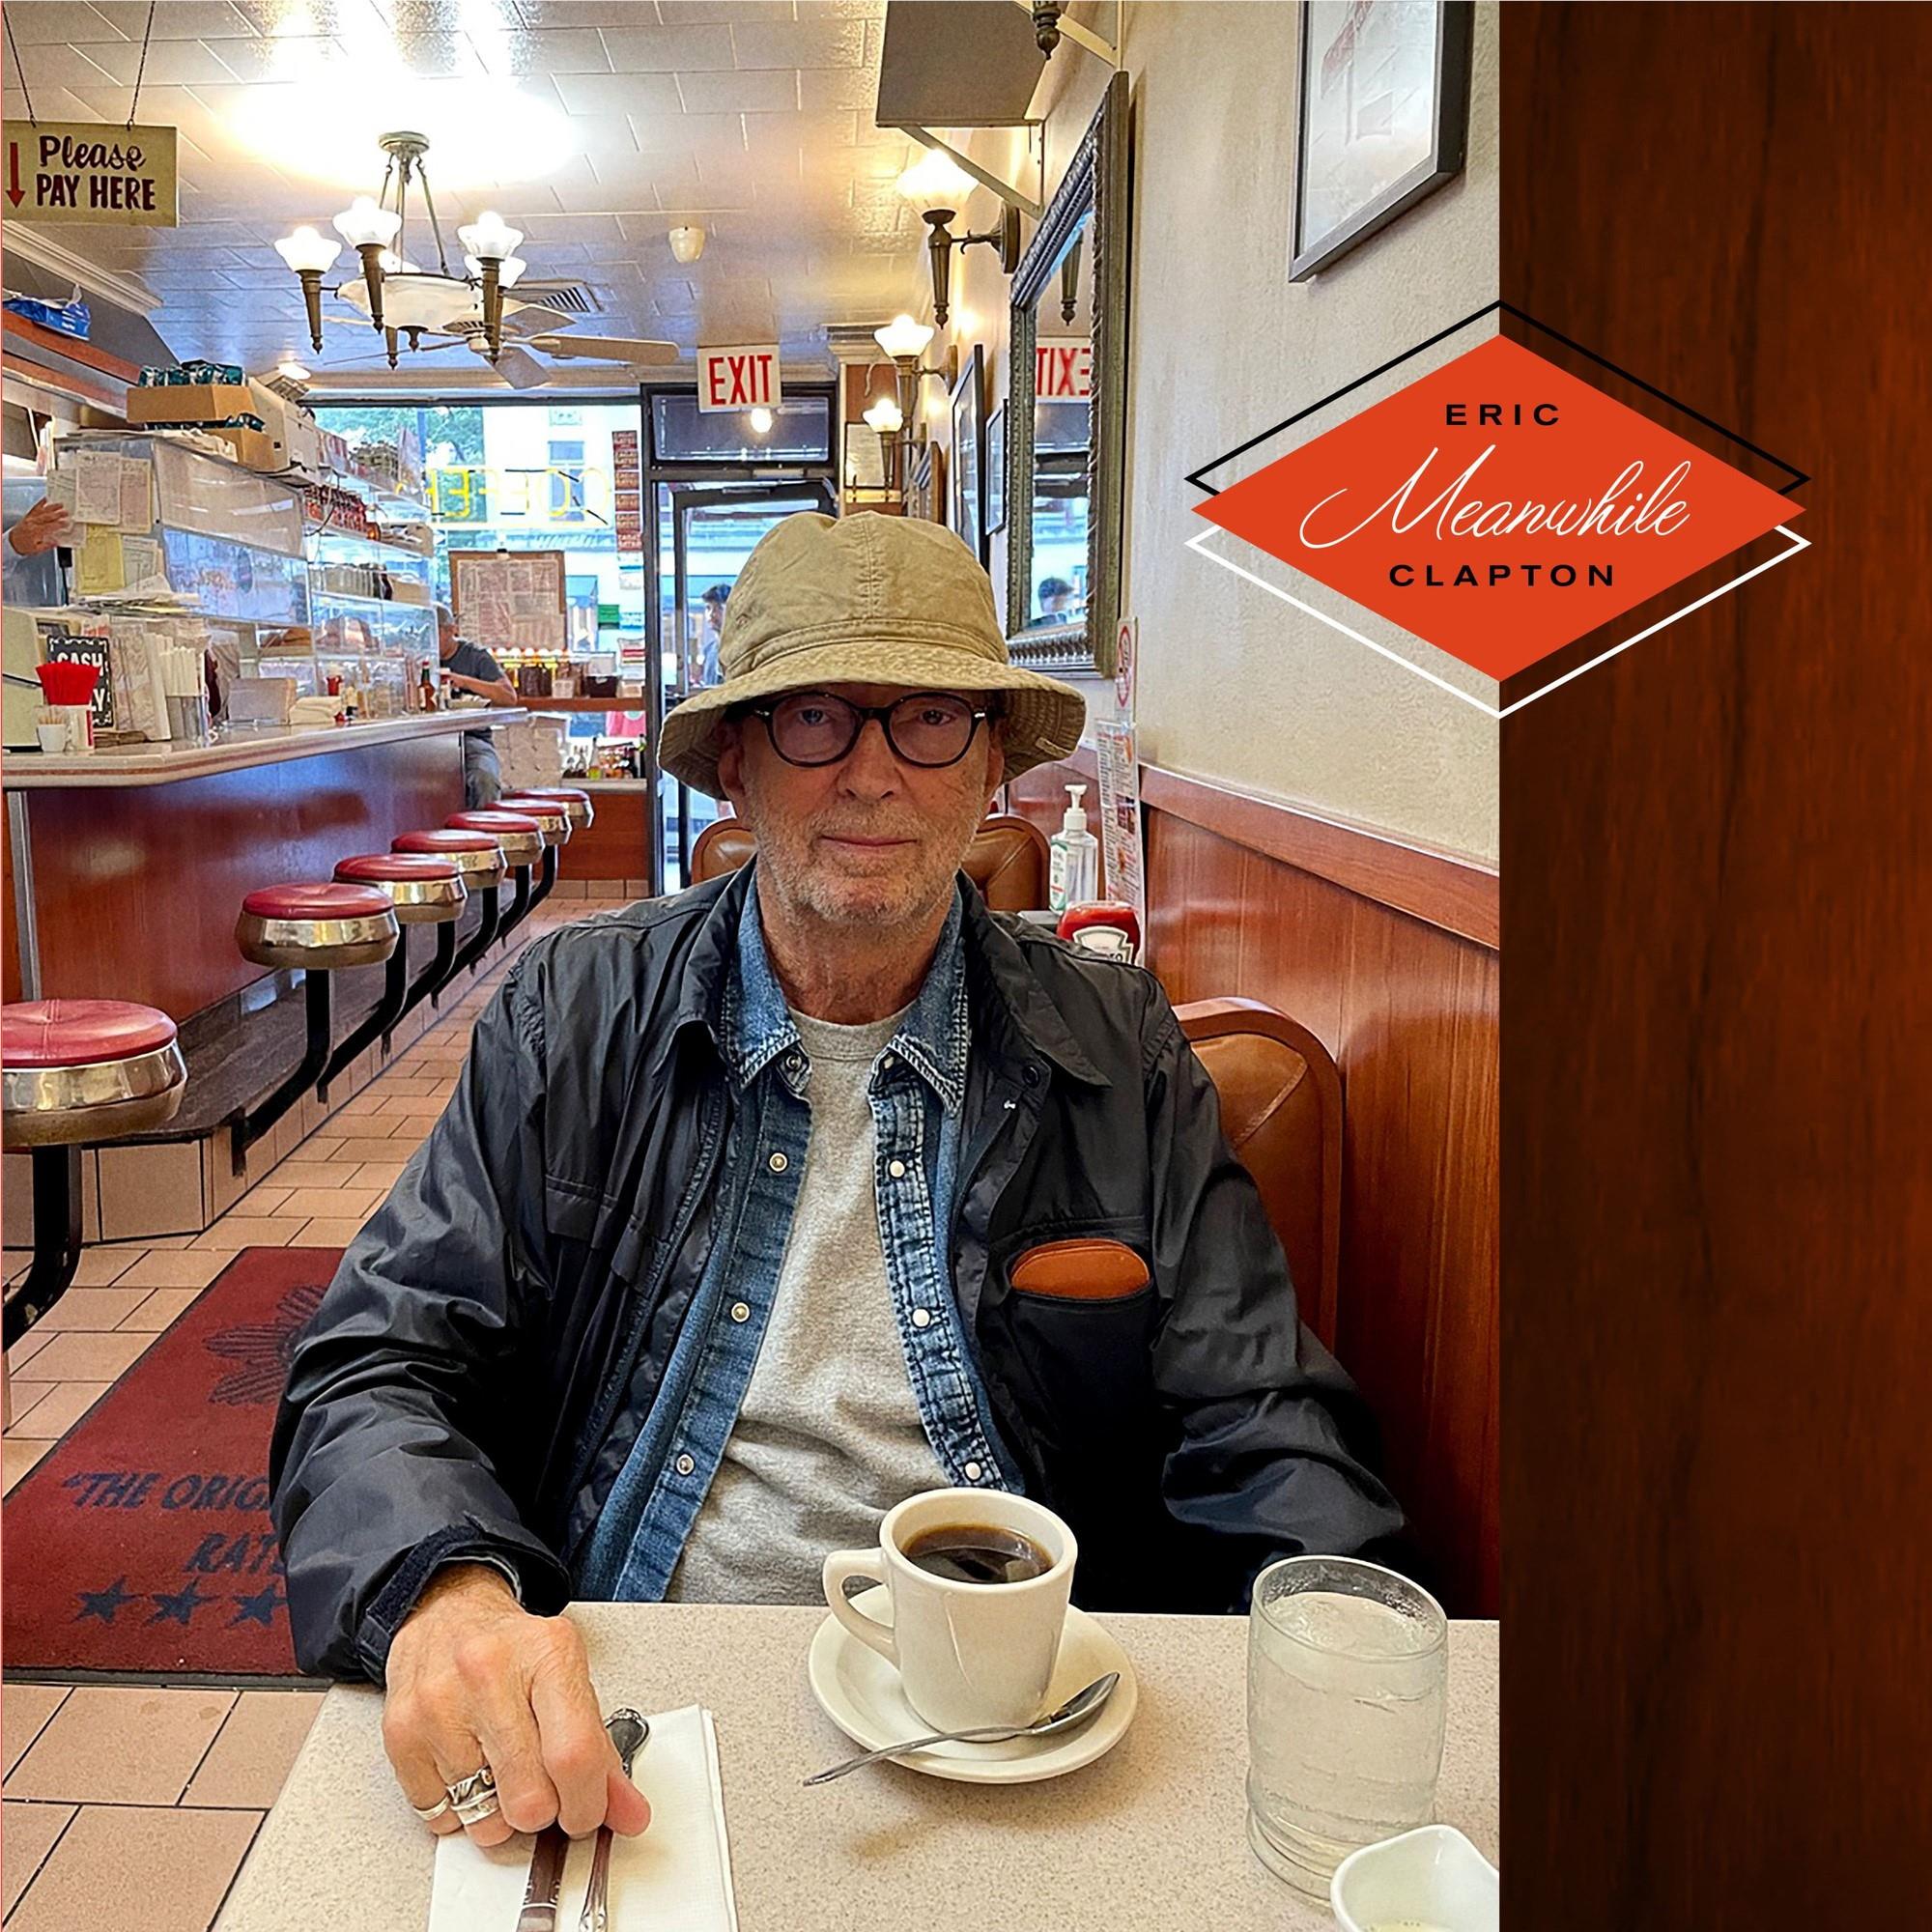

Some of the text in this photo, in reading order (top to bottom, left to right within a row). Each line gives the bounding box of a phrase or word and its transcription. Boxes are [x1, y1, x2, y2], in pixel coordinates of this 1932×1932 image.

[40, 135, 147, 172] Please
[37, 174, 156, 211] PAY HERE
[709, 355, 773, 406] EXIT
[160, 1474, 270, 1510] ORIG
